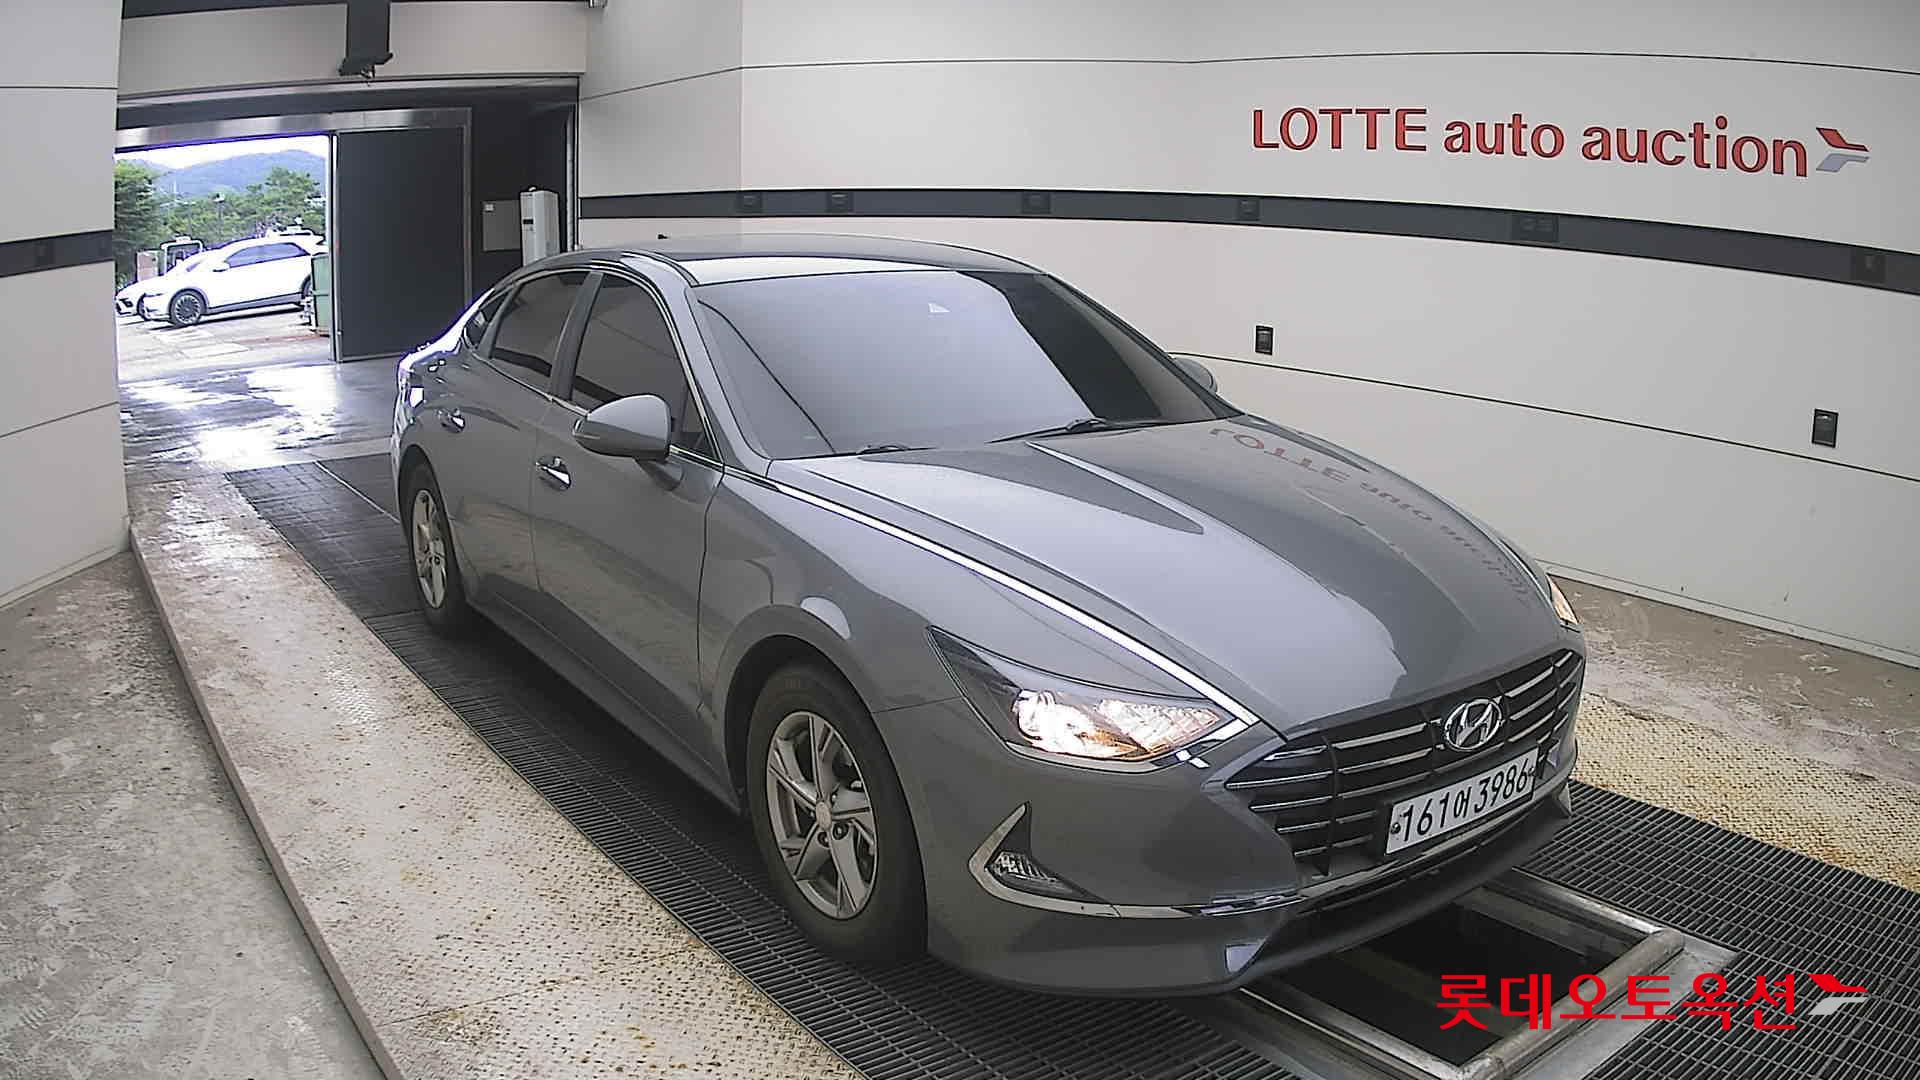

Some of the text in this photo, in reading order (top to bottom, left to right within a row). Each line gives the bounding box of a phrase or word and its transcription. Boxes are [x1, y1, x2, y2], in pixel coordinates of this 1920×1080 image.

[1252, 107, 1809, 178] LOTTE auto auction
[1401, 758, 1529, 842] 161어 3986
